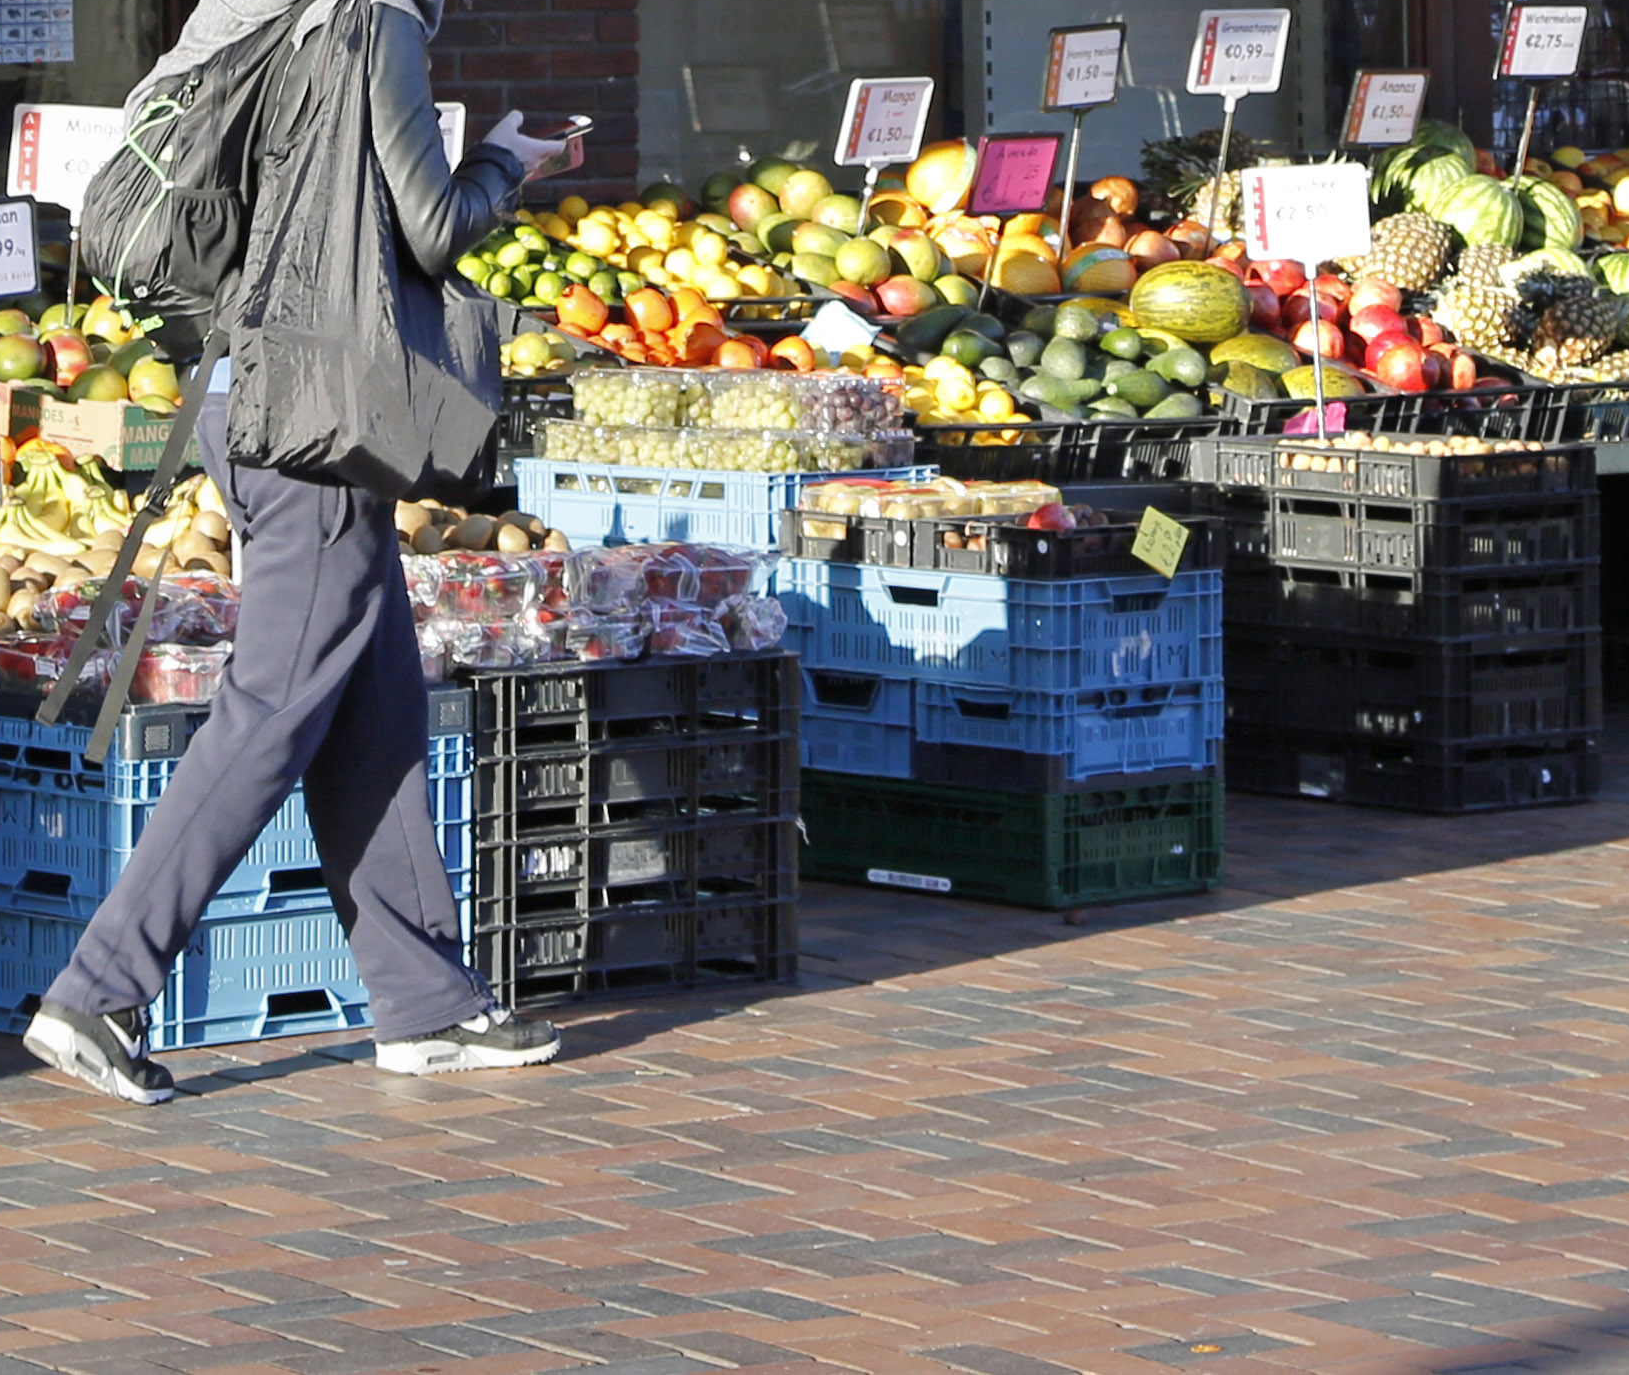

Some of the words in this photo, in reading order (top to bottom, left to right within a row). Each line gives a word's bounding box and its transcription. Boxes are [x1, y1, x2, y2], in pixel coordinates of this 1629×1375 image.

[1526, 34, 1563, 50] €2,75
[1225, 44, 1263, 61] €0,99
[1379, 80, 1417, 94] Ananas
[882, 90, 916, 107] Mango
[867, 127, 903, 143] €1,50
